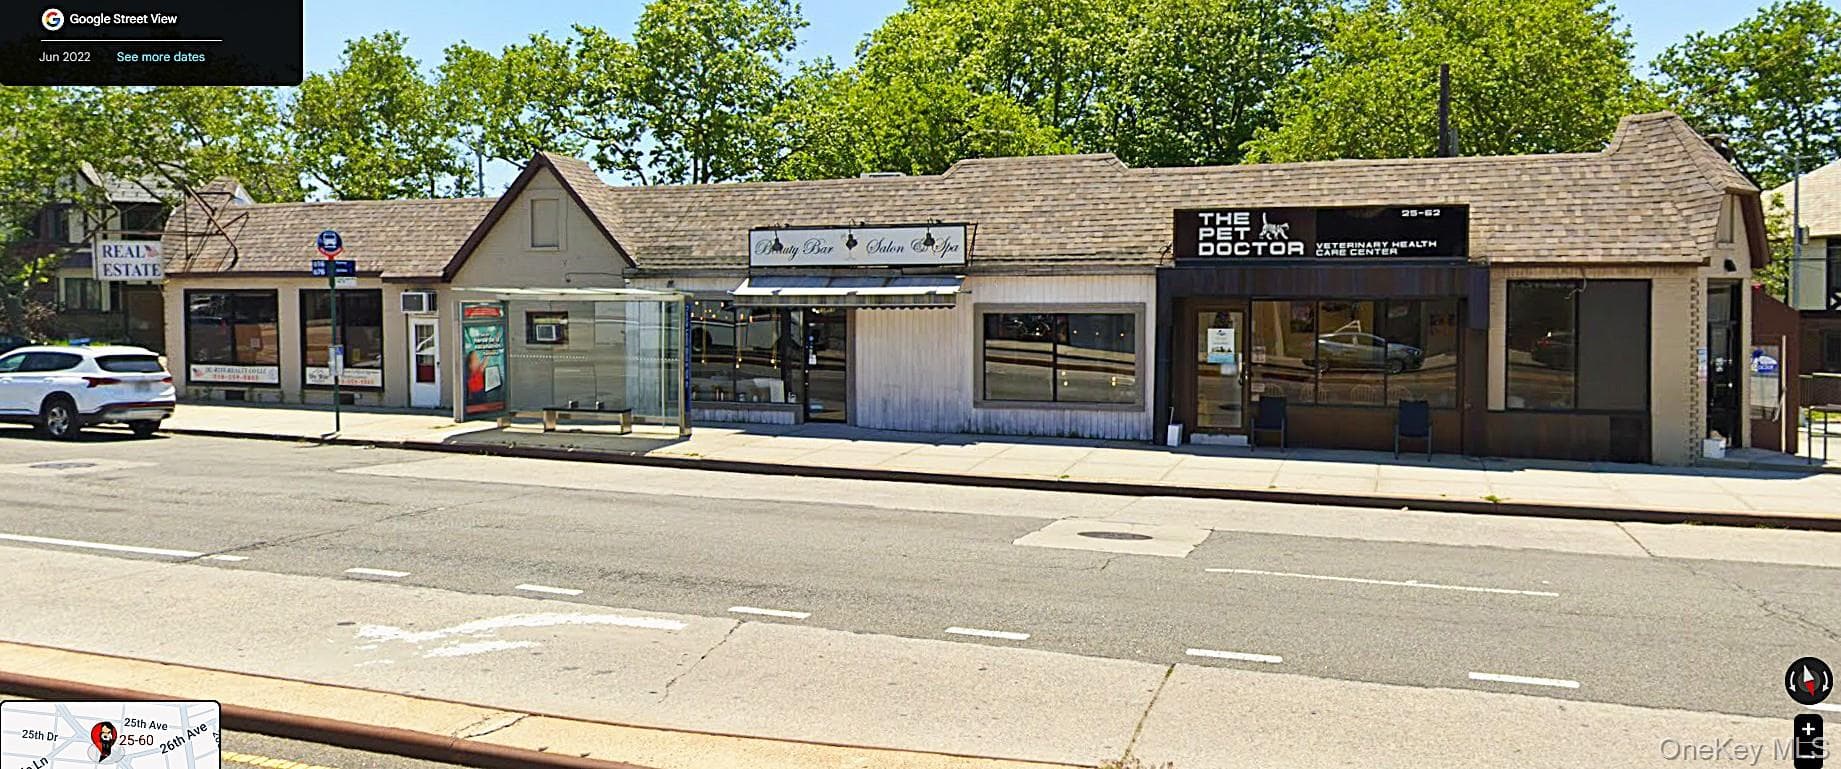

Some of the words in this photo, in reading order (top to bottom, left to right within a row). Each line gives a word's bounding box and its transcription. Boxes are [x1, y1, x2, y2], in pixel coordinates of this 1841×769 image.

[1198, 212, 1250, 226] THE
[1401, 209, 1441, 217] 25-62
[1198, 227, 1251, 240] PET
[102, 244, 146, 258] REAL
[802, 238, 834, 254] Bar
[866, 237, 905, 254] Salon
[931, 236, 960, 259] Spa
[1198, 242, 1305, 256] DOCTOR
[1315, 242, 1389, 250] VETERINARY
[1391, 240, 1438, 248] HEALTH
[1315, 249, 1347, 257] CARE
[1349, 248, 1399, 256] CENTER
[103, 263, 162, 277] ESTATE
